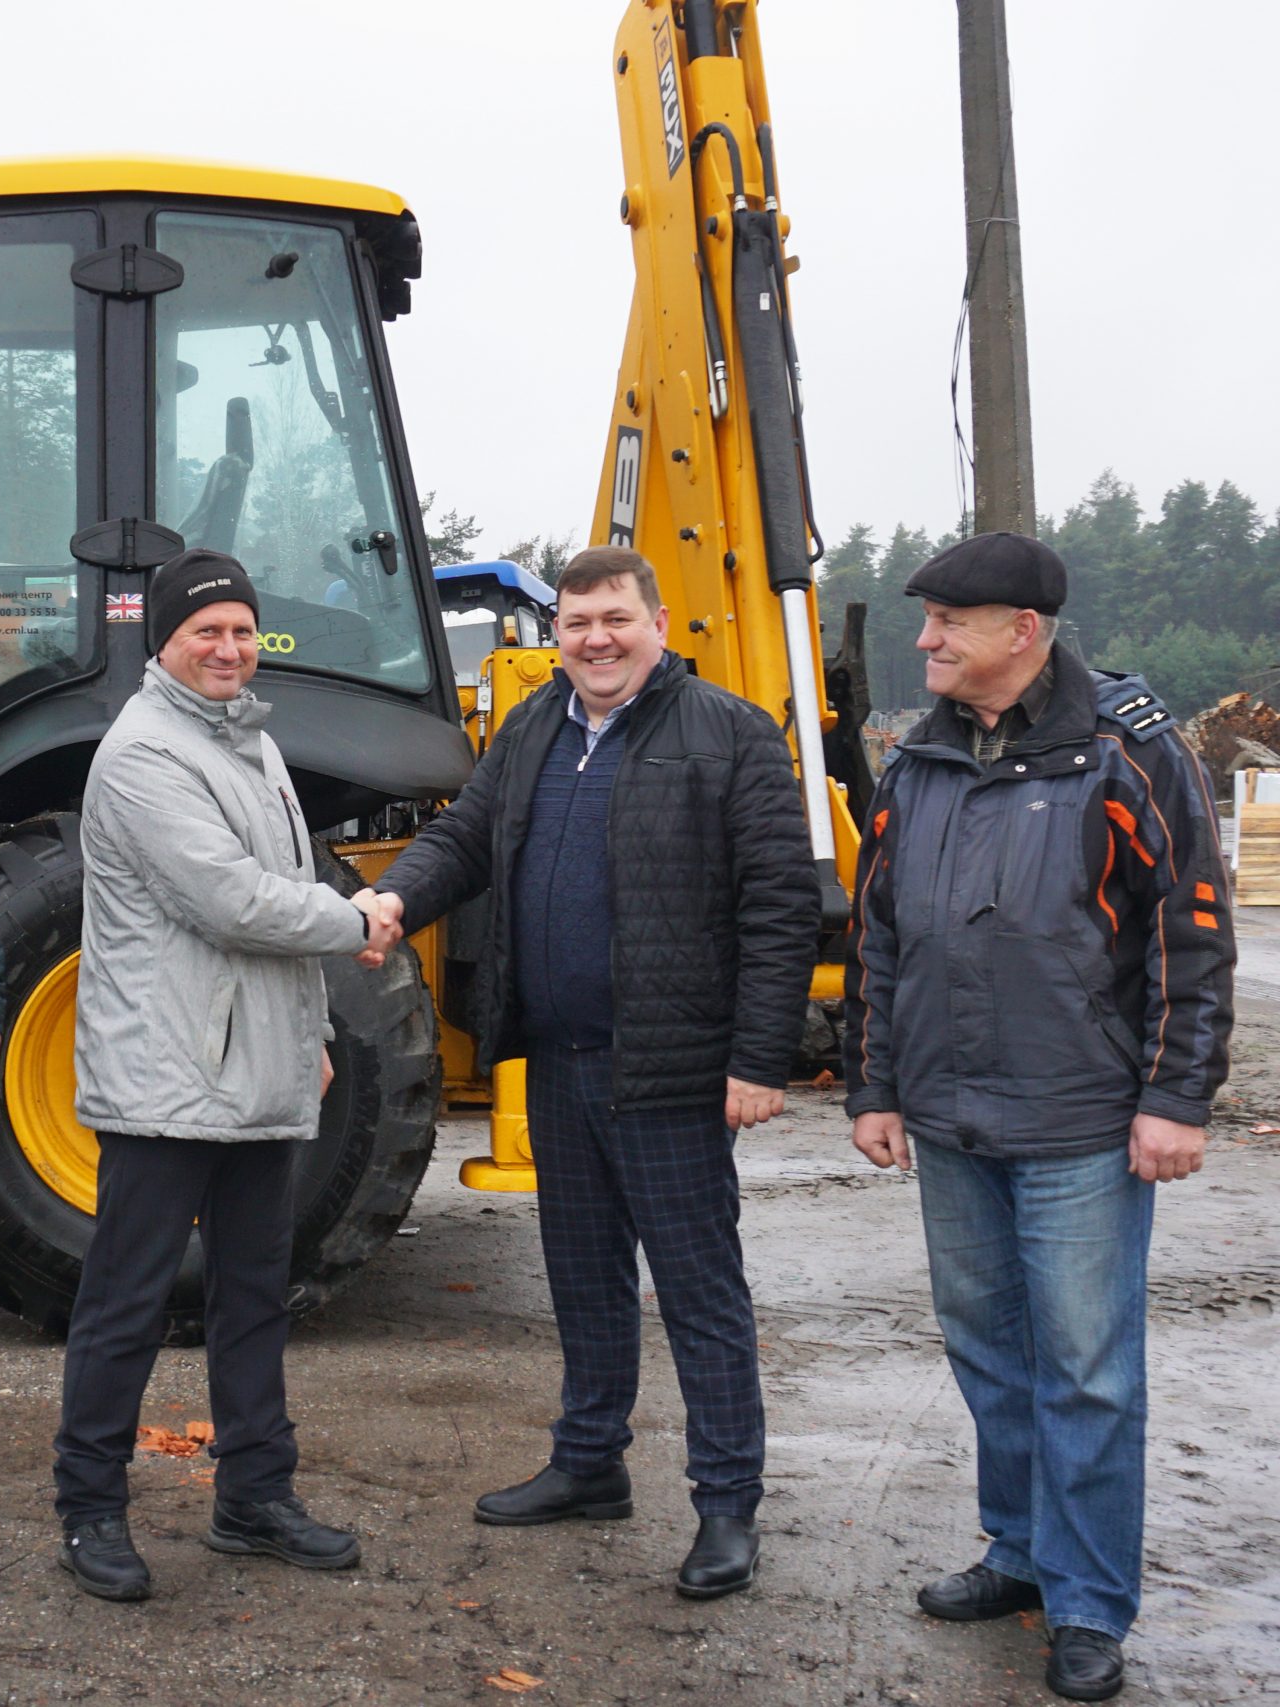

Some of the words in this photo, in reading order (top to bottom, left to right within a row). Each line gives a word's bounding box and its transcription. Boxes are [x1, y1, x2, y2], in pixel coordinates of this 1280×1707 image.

[660, 60, 683, 166] 3CX
[20, 591, 53, 601] центр
[15, 608, 27, 617] 33
[30, 607, 42, 617] 55
[45, 607, 57, 617] 55
